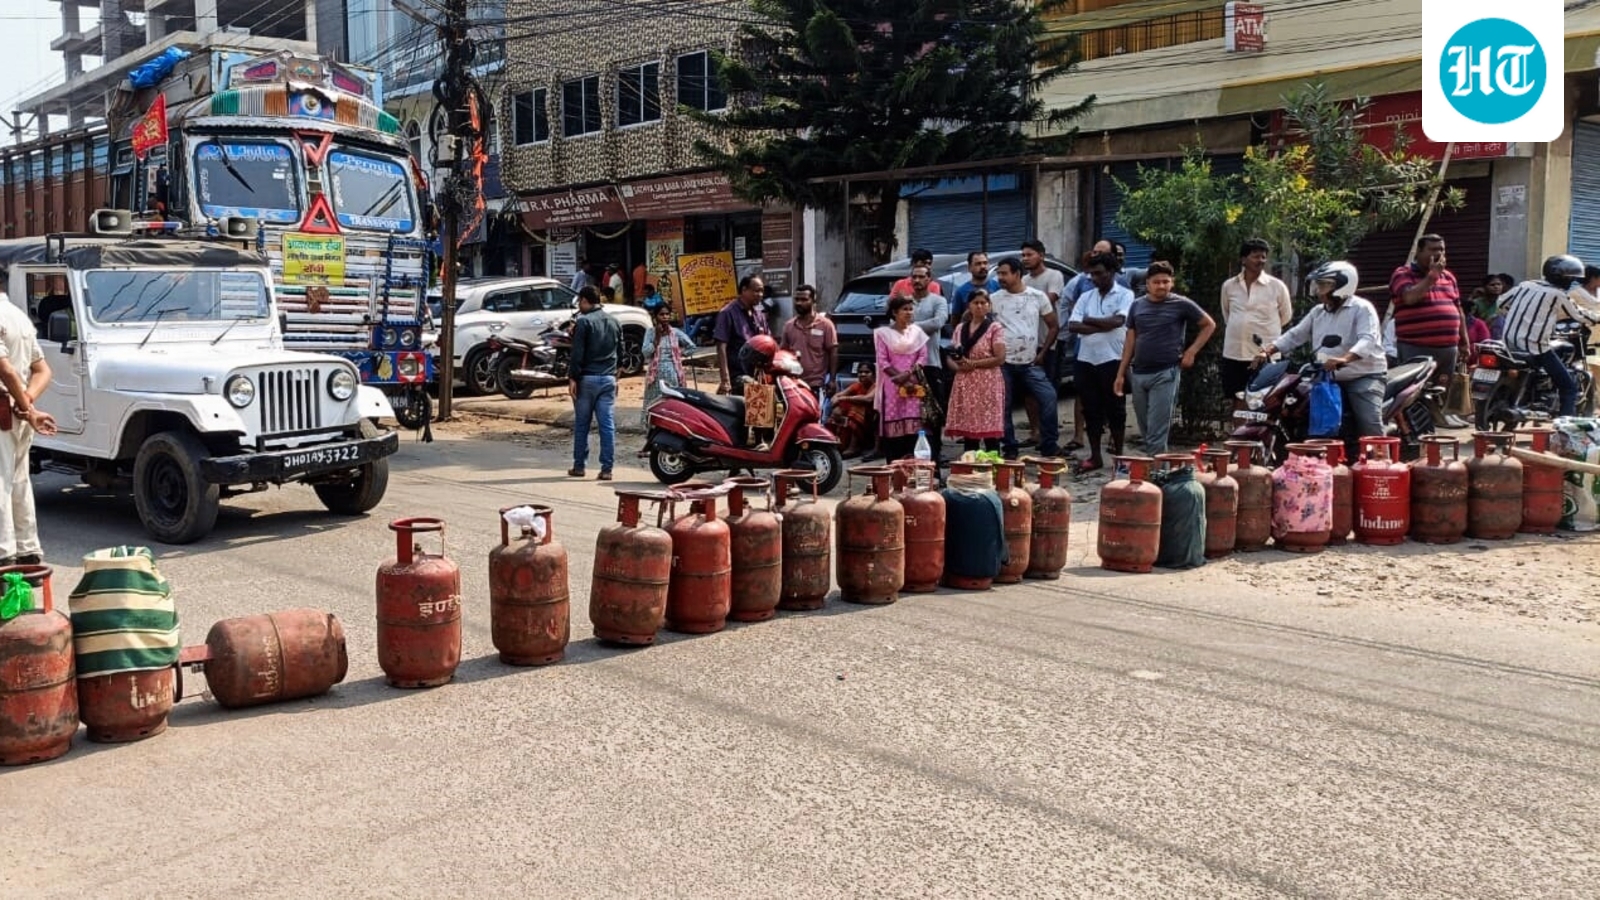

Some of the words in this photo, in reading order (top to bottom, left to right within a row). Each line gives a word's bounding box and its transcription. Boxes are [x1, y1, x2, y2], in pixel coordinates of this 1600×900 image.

[1235, 18, 1264, 36] ATM
[1385, 108, 1419, 123] mini
[237, 146, 276, 158] India
[529, 199, 554, 212] R.K.
[554, 191, 609, 209] PHARMA
